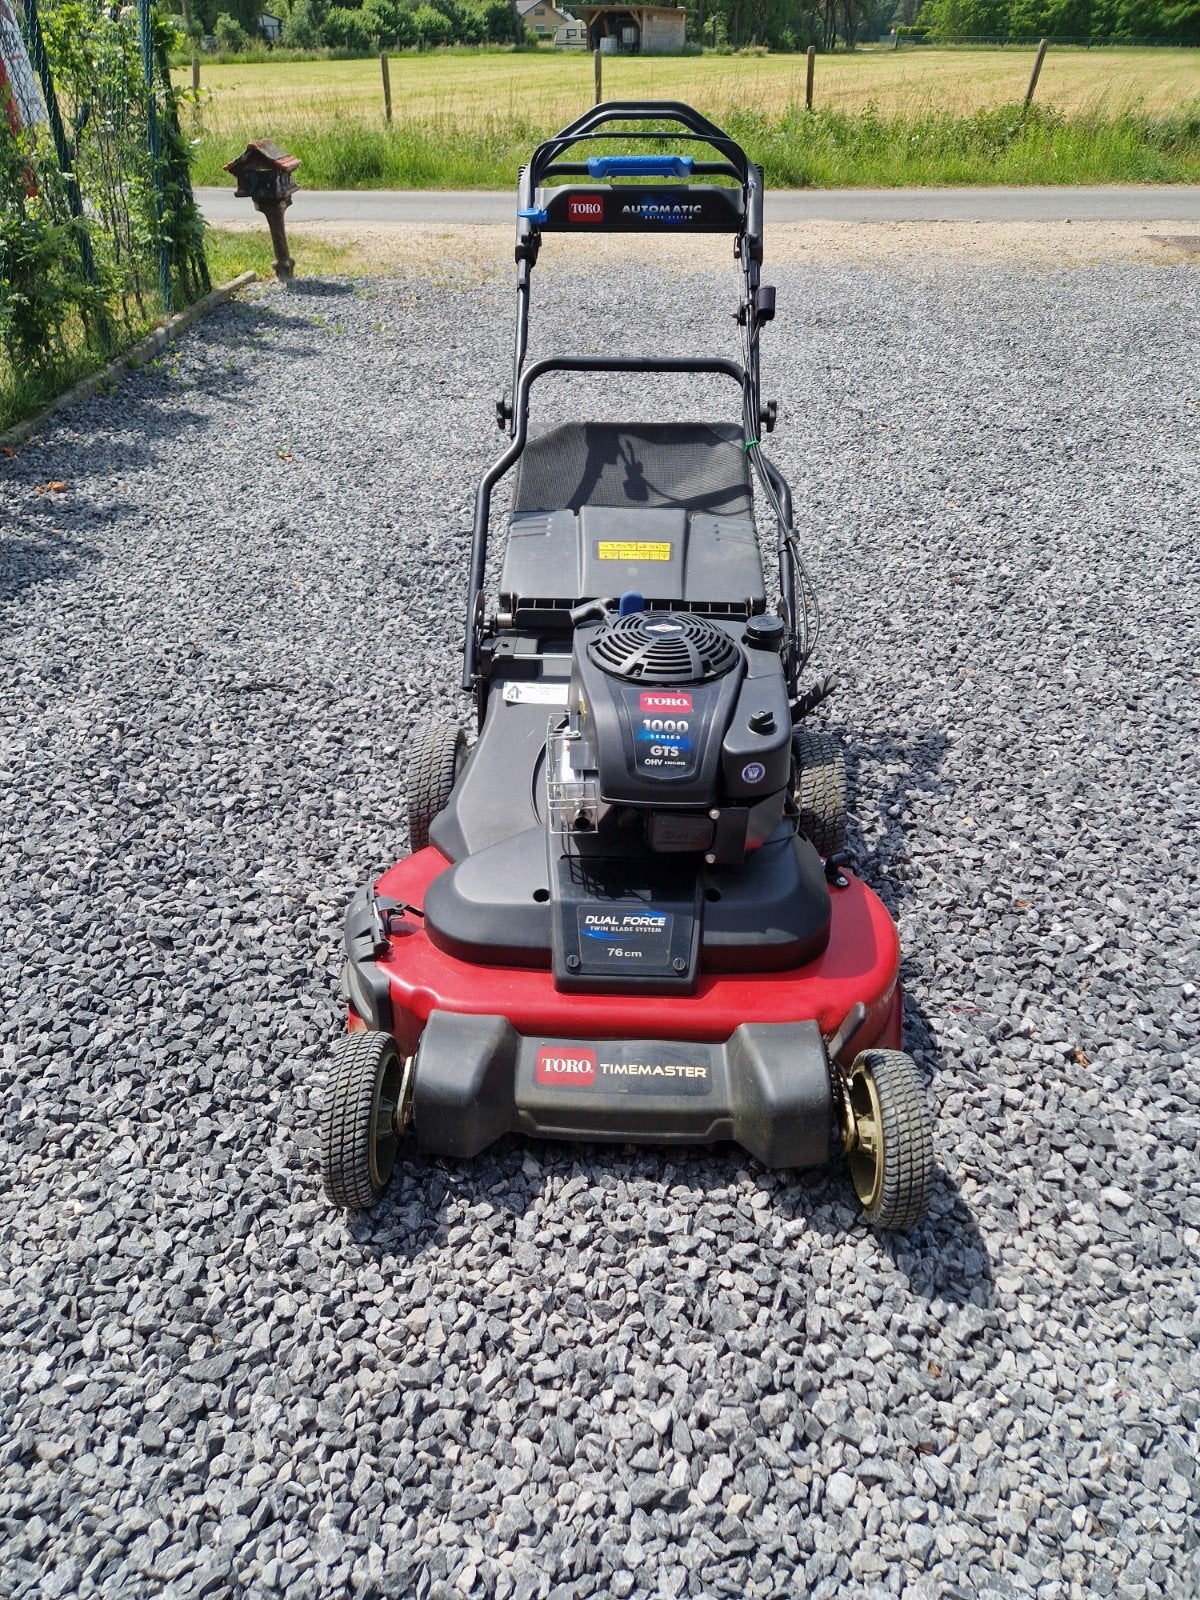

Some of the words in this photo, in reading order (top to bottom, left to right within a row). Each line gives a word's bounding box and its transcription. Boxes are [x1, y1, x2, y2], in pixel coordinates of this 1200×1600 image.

[571, 203, 601, 214] TORO
[622, 204, 702, 213] AUTOMATIC
[644, 697, 689, 706] TORO
[643, 719, 689, 733] 1000
[650, 745, 679, 756] GTS
[585, 916, 619, 925] DUAL
[623, 917, 666, 926] FORCE
[600, 1063, 707, 1078] TIMEMASTER
